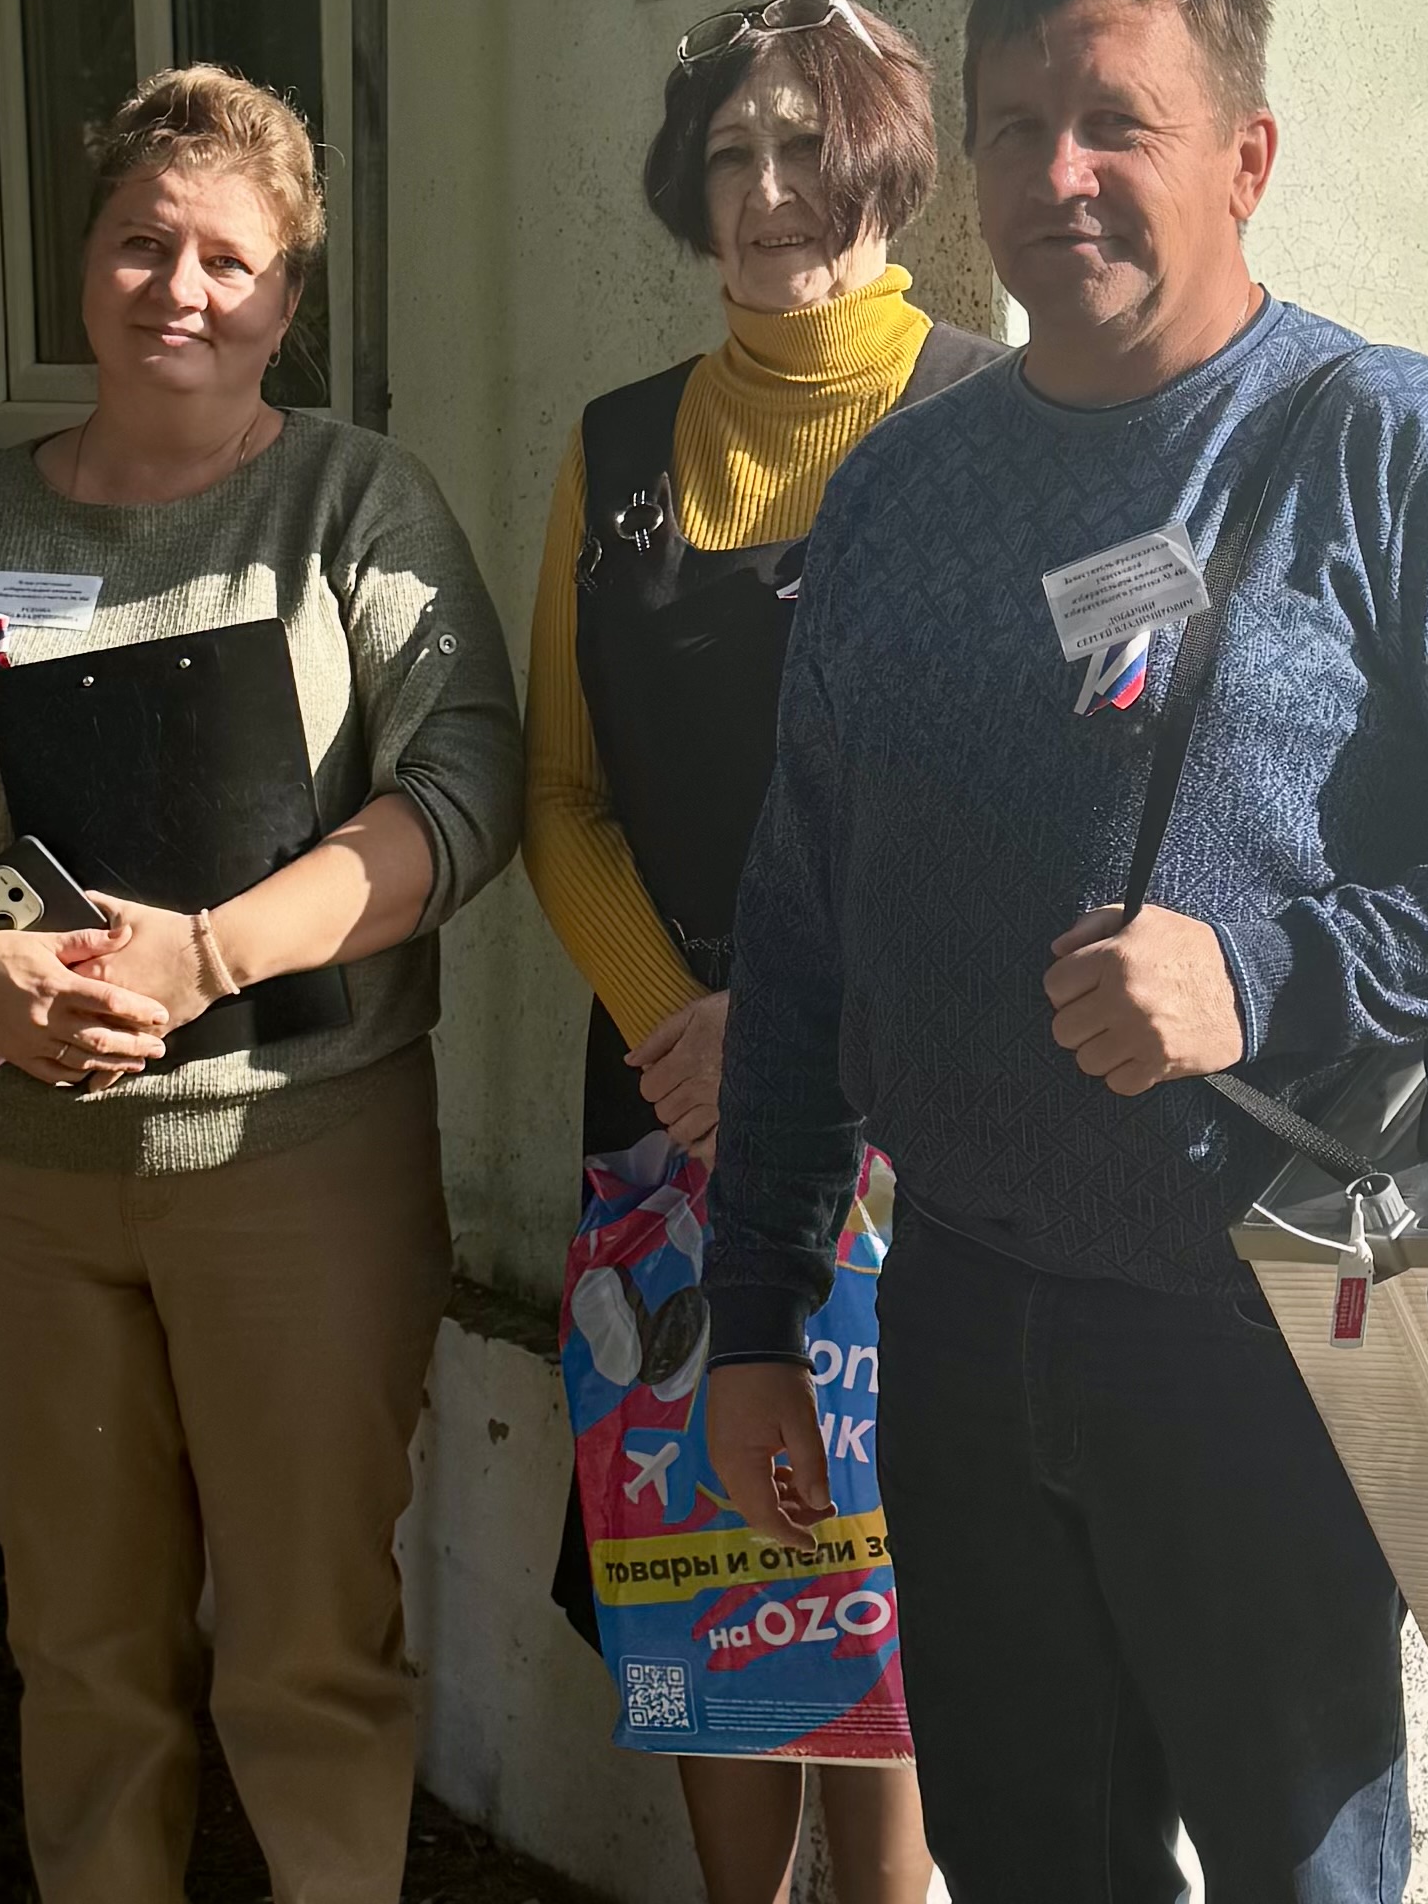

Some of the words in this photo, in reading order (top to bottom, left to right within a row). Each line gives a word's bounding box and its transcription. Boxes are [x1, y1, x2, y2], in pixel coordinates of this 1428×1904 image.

[605, 1554, 719, 1587] товары
[727, 1551, 750, 1574] и
[865, 1535, 889, 1558] з
[709, 1624, 752, 1650] на
[755, 1589, 894, 1647] OZO
